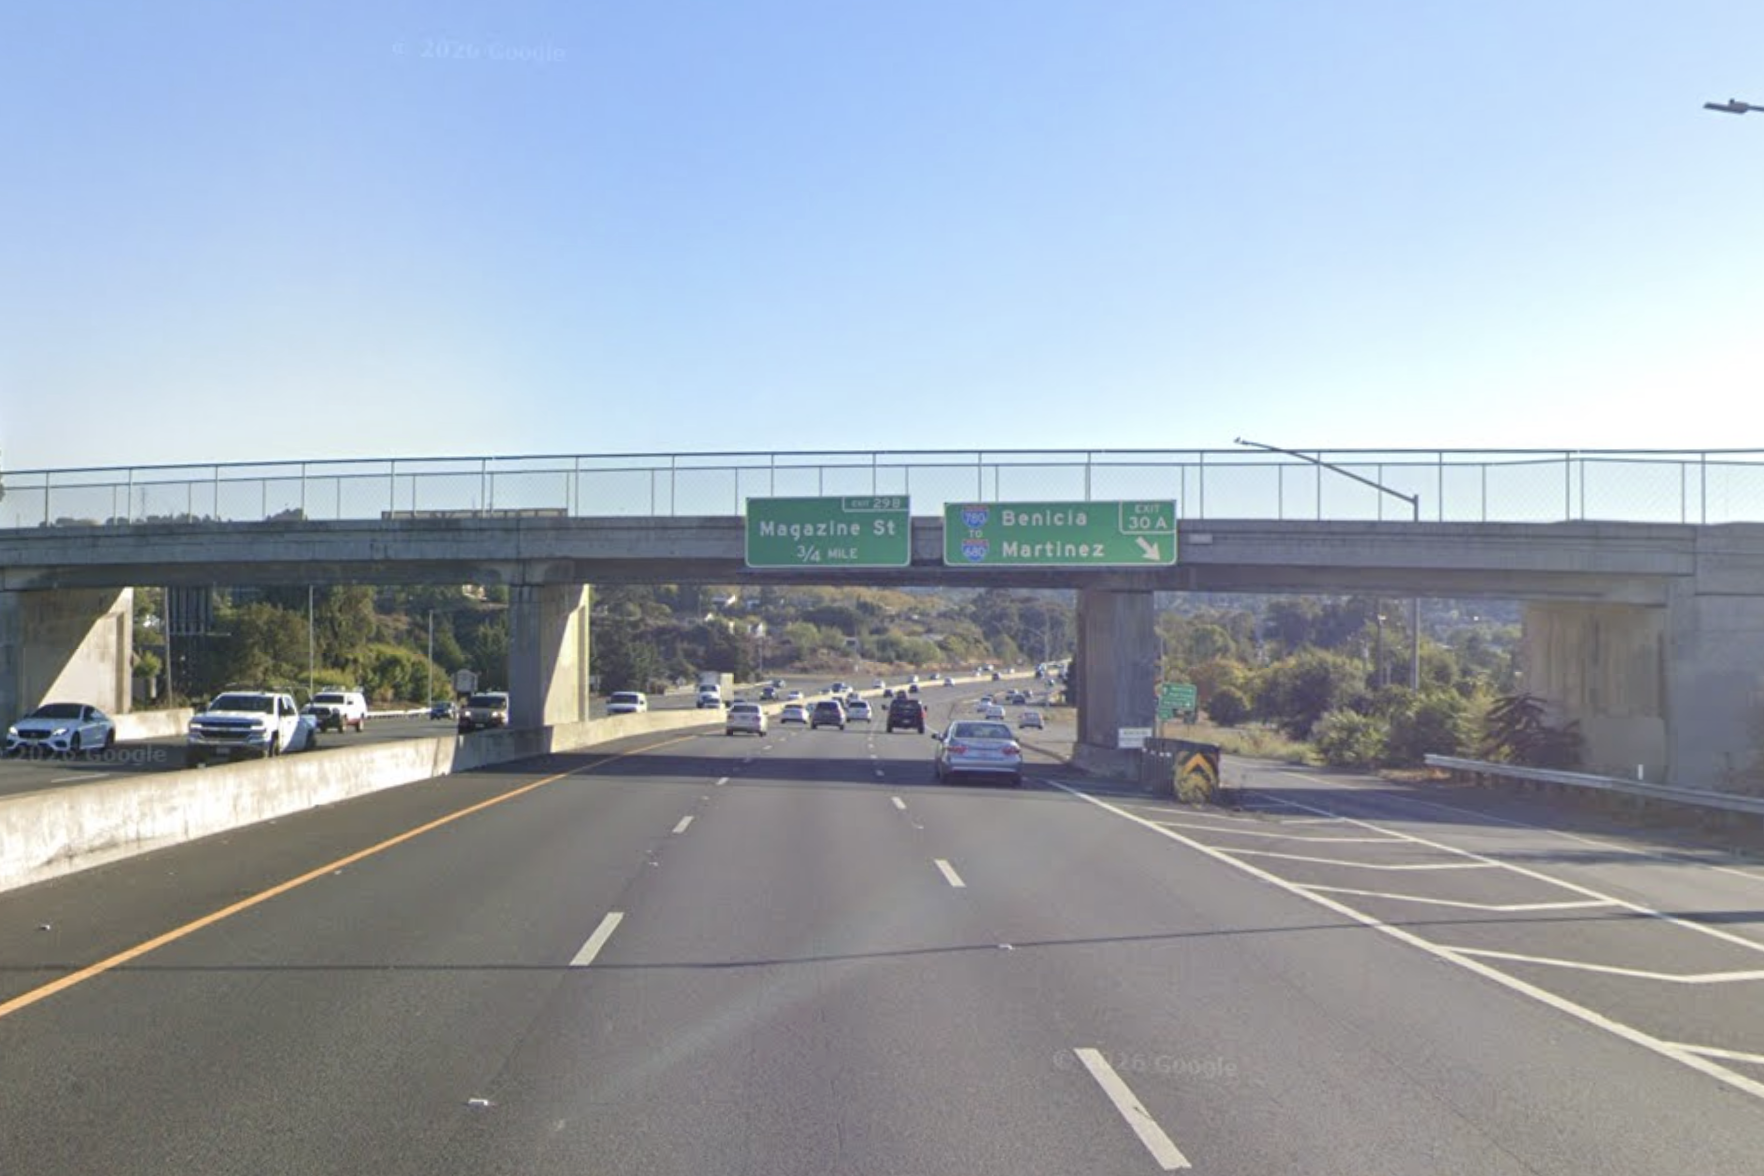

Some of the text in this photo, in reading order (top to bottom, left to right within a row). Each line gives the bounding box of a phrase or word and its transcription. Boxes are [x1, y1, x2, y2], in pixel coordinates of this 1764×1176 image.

[1134, 504, 1160, 514] EXIT
[1002, 509, 1088, 526] Benicia
[1128, 516, 1168, 529] 30 A
[759, 519, 896, 541] Magazine St
[969, 529, 983, 538] TO
[828, 548, 858, 559] MILE
[1002, 540, 1105, 558] Martinez
